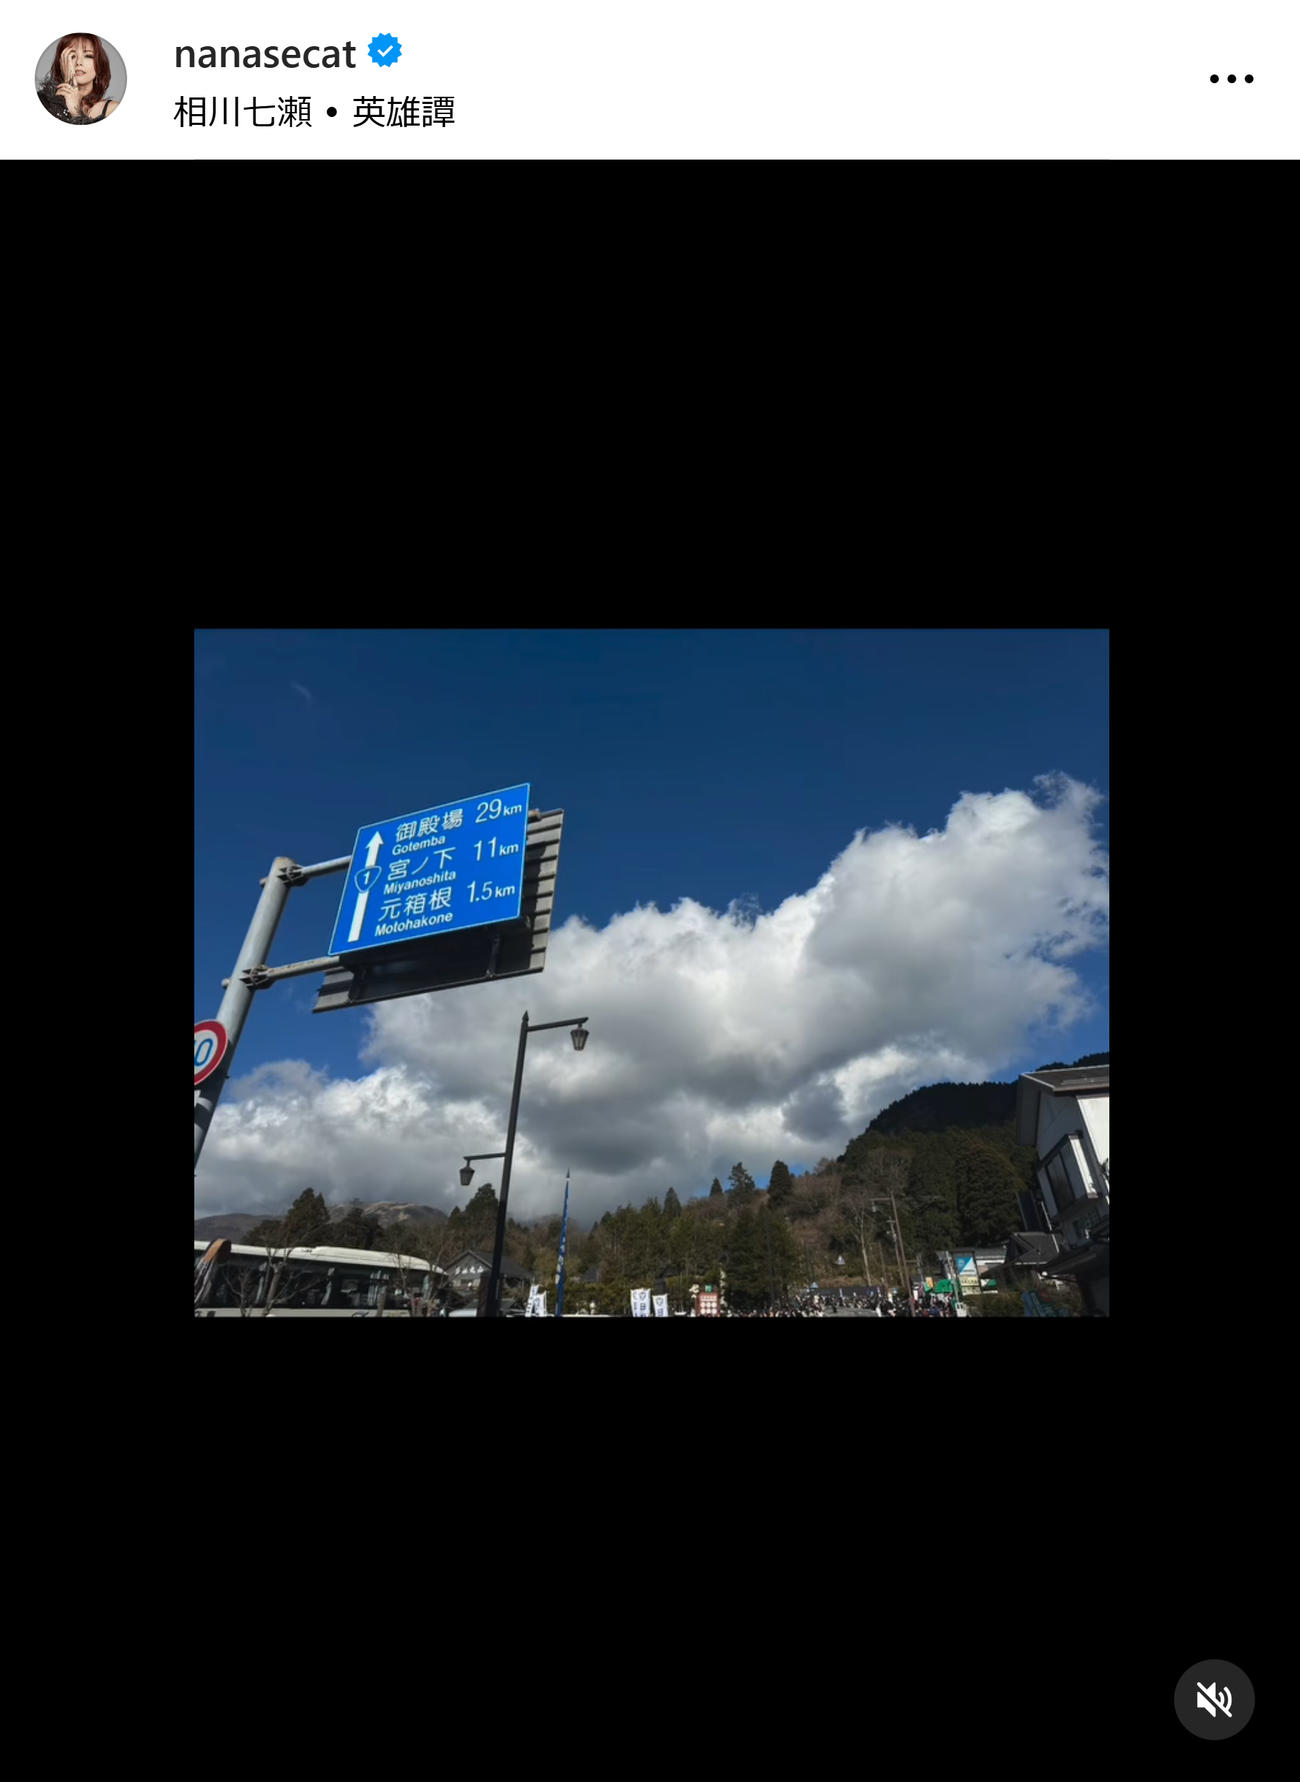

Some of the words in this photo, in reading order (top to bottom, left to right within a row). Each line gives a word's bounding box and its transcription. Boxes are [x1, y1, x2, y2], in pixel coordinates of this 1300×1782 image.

[395, 809, 463, 843] 御殿場
[392, 835, 446, 856] Gotemba
[388, 846, 456, 881] 宮ノ下
[363, 872, 371, 884] 1
[384, 870, 456, 896] Miyanoshita
[378, 886, 452, 922] 元箱根
[374, 912, 453, 937] Motohakone
